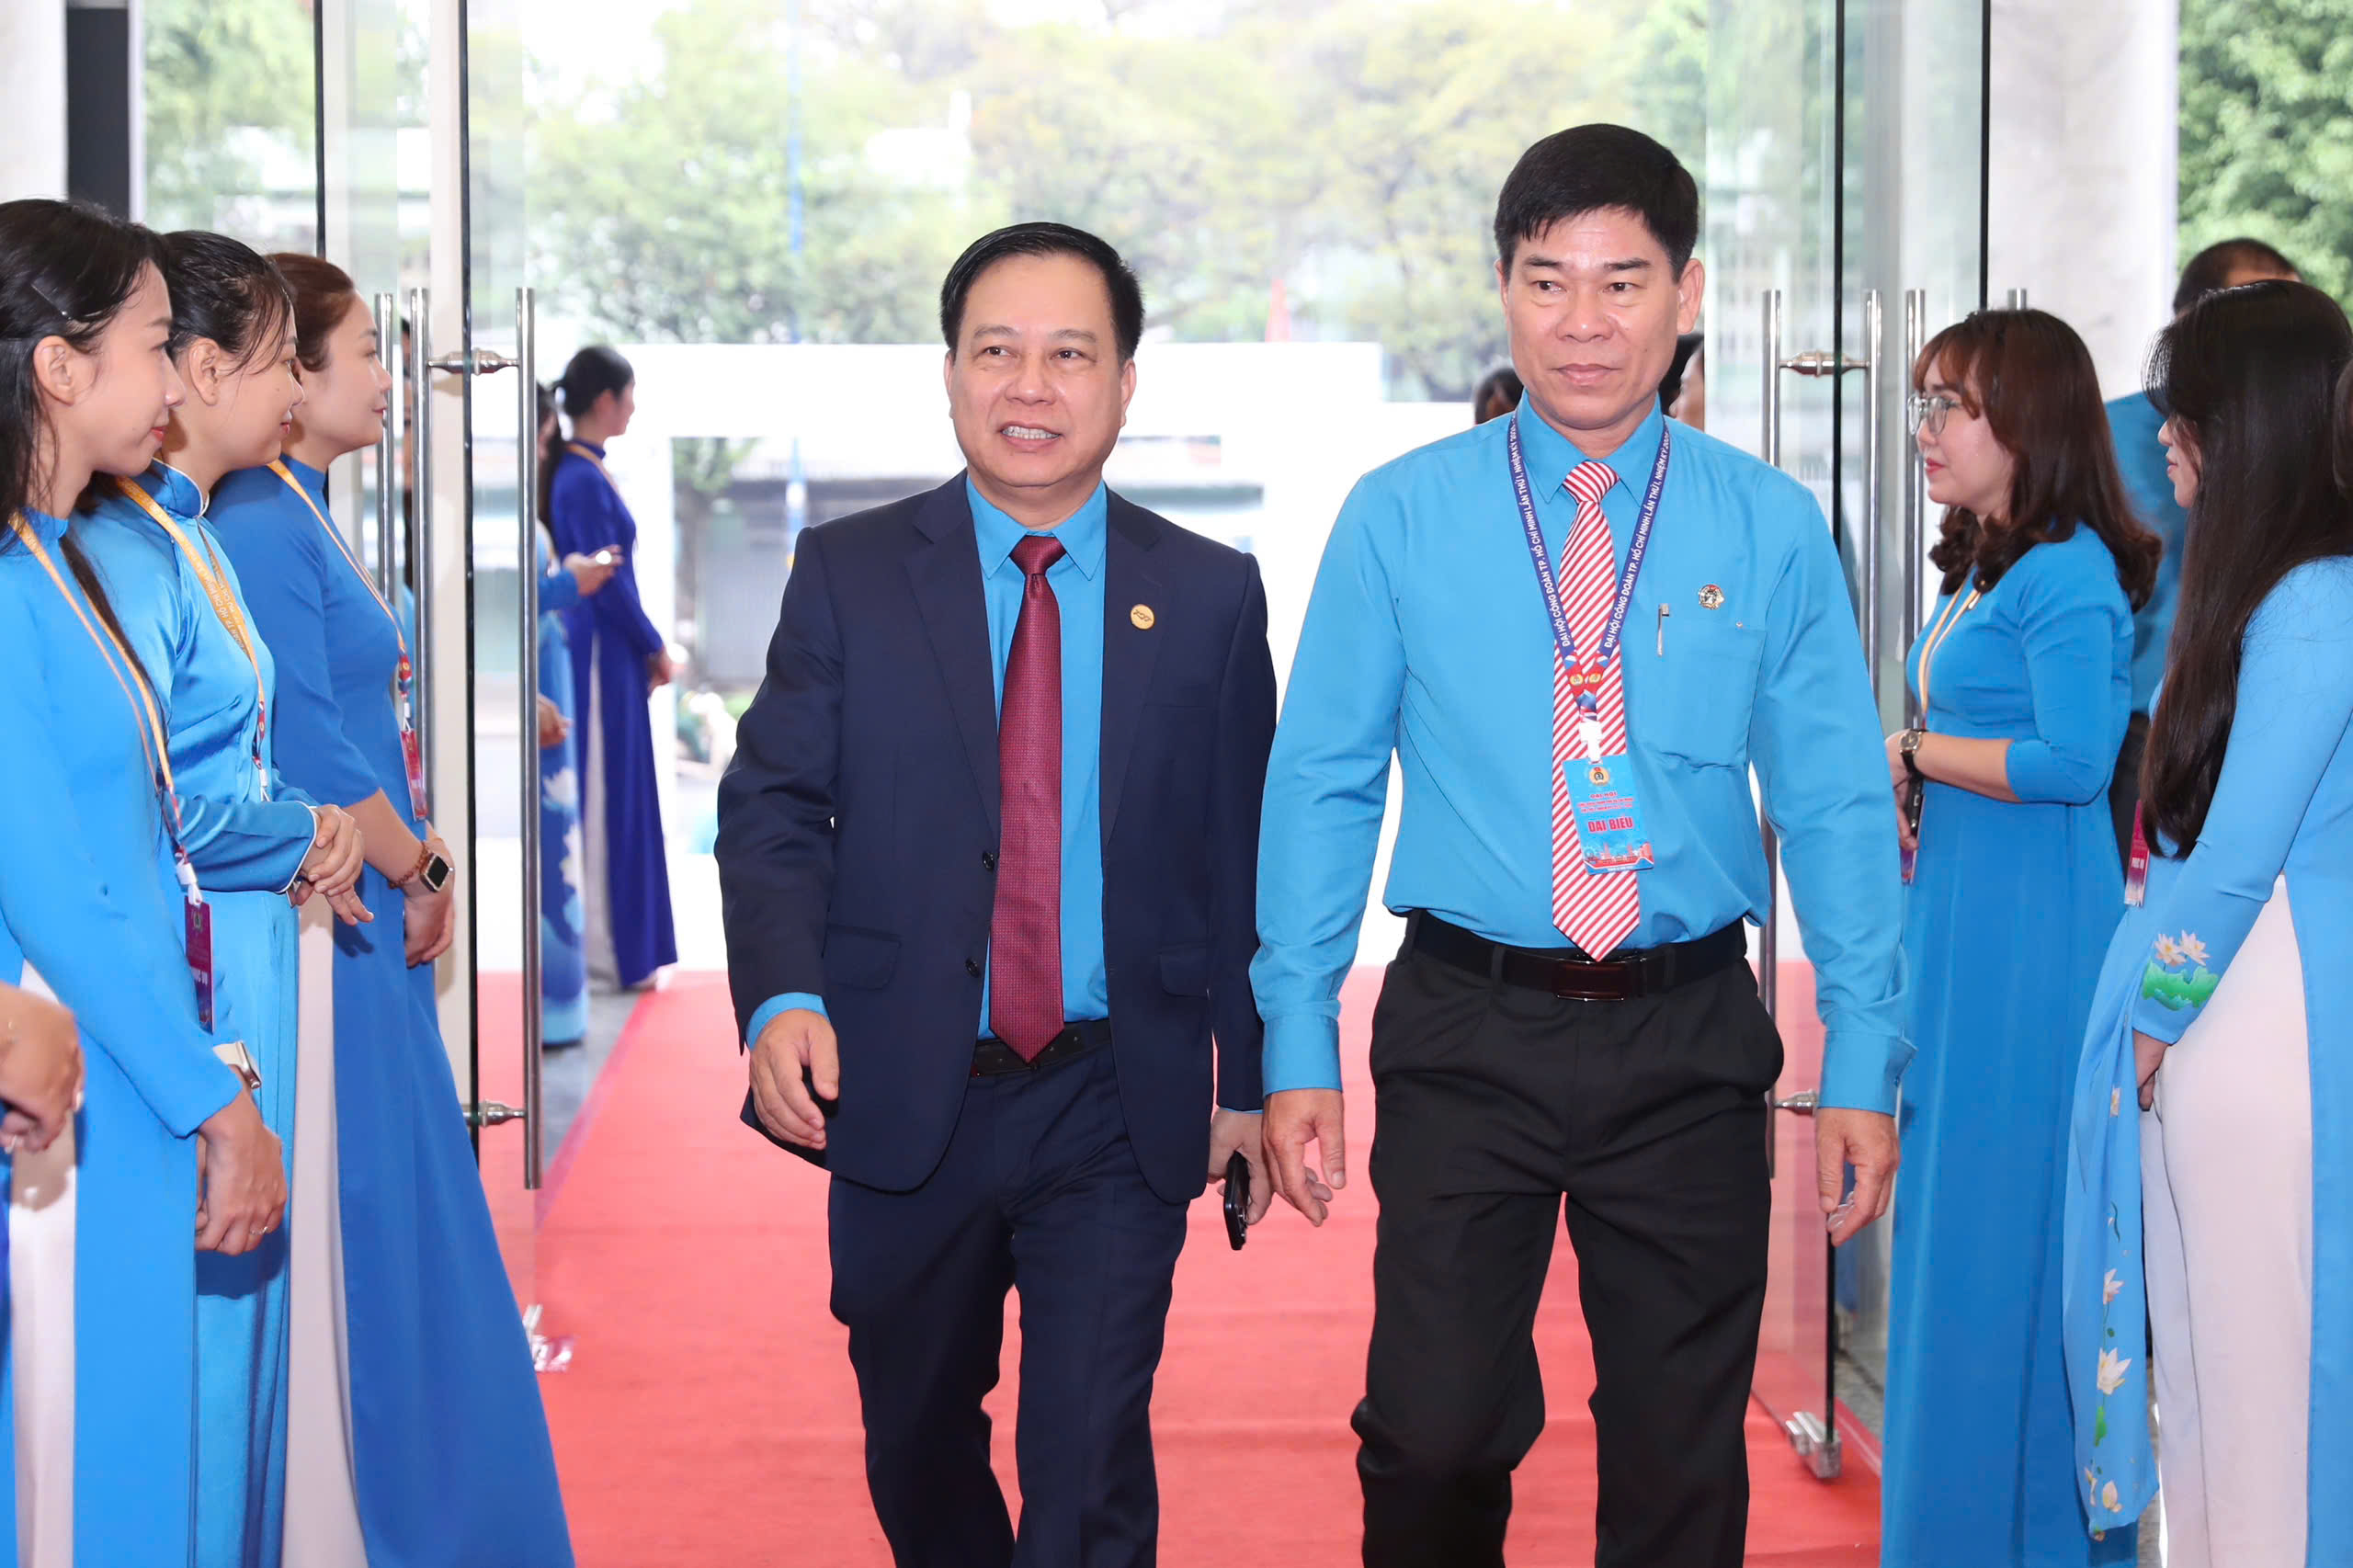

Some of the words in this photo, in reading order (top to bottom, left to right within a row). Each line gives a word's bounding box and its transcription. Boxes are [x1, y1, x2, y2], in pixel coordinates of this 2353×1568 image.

[1524, 510, 1537, 530] MINH
[1639, 516, 1651, 535] MINH
[1528, 530, 1540, 544] CHÍ
[1635, 533, 1645, 548] CHÍ
[1538, 557, 1547, 571] TP.
[1627, 560, 1639, 572] TP.
[1540, 571, 1554, 594] ĐOÀN
[1620, 573, 1634, 596] ĐOÀN
[1547, 594, 1561, 617] CÔNG
[1613, 596, 1627, 619] CÔNG
